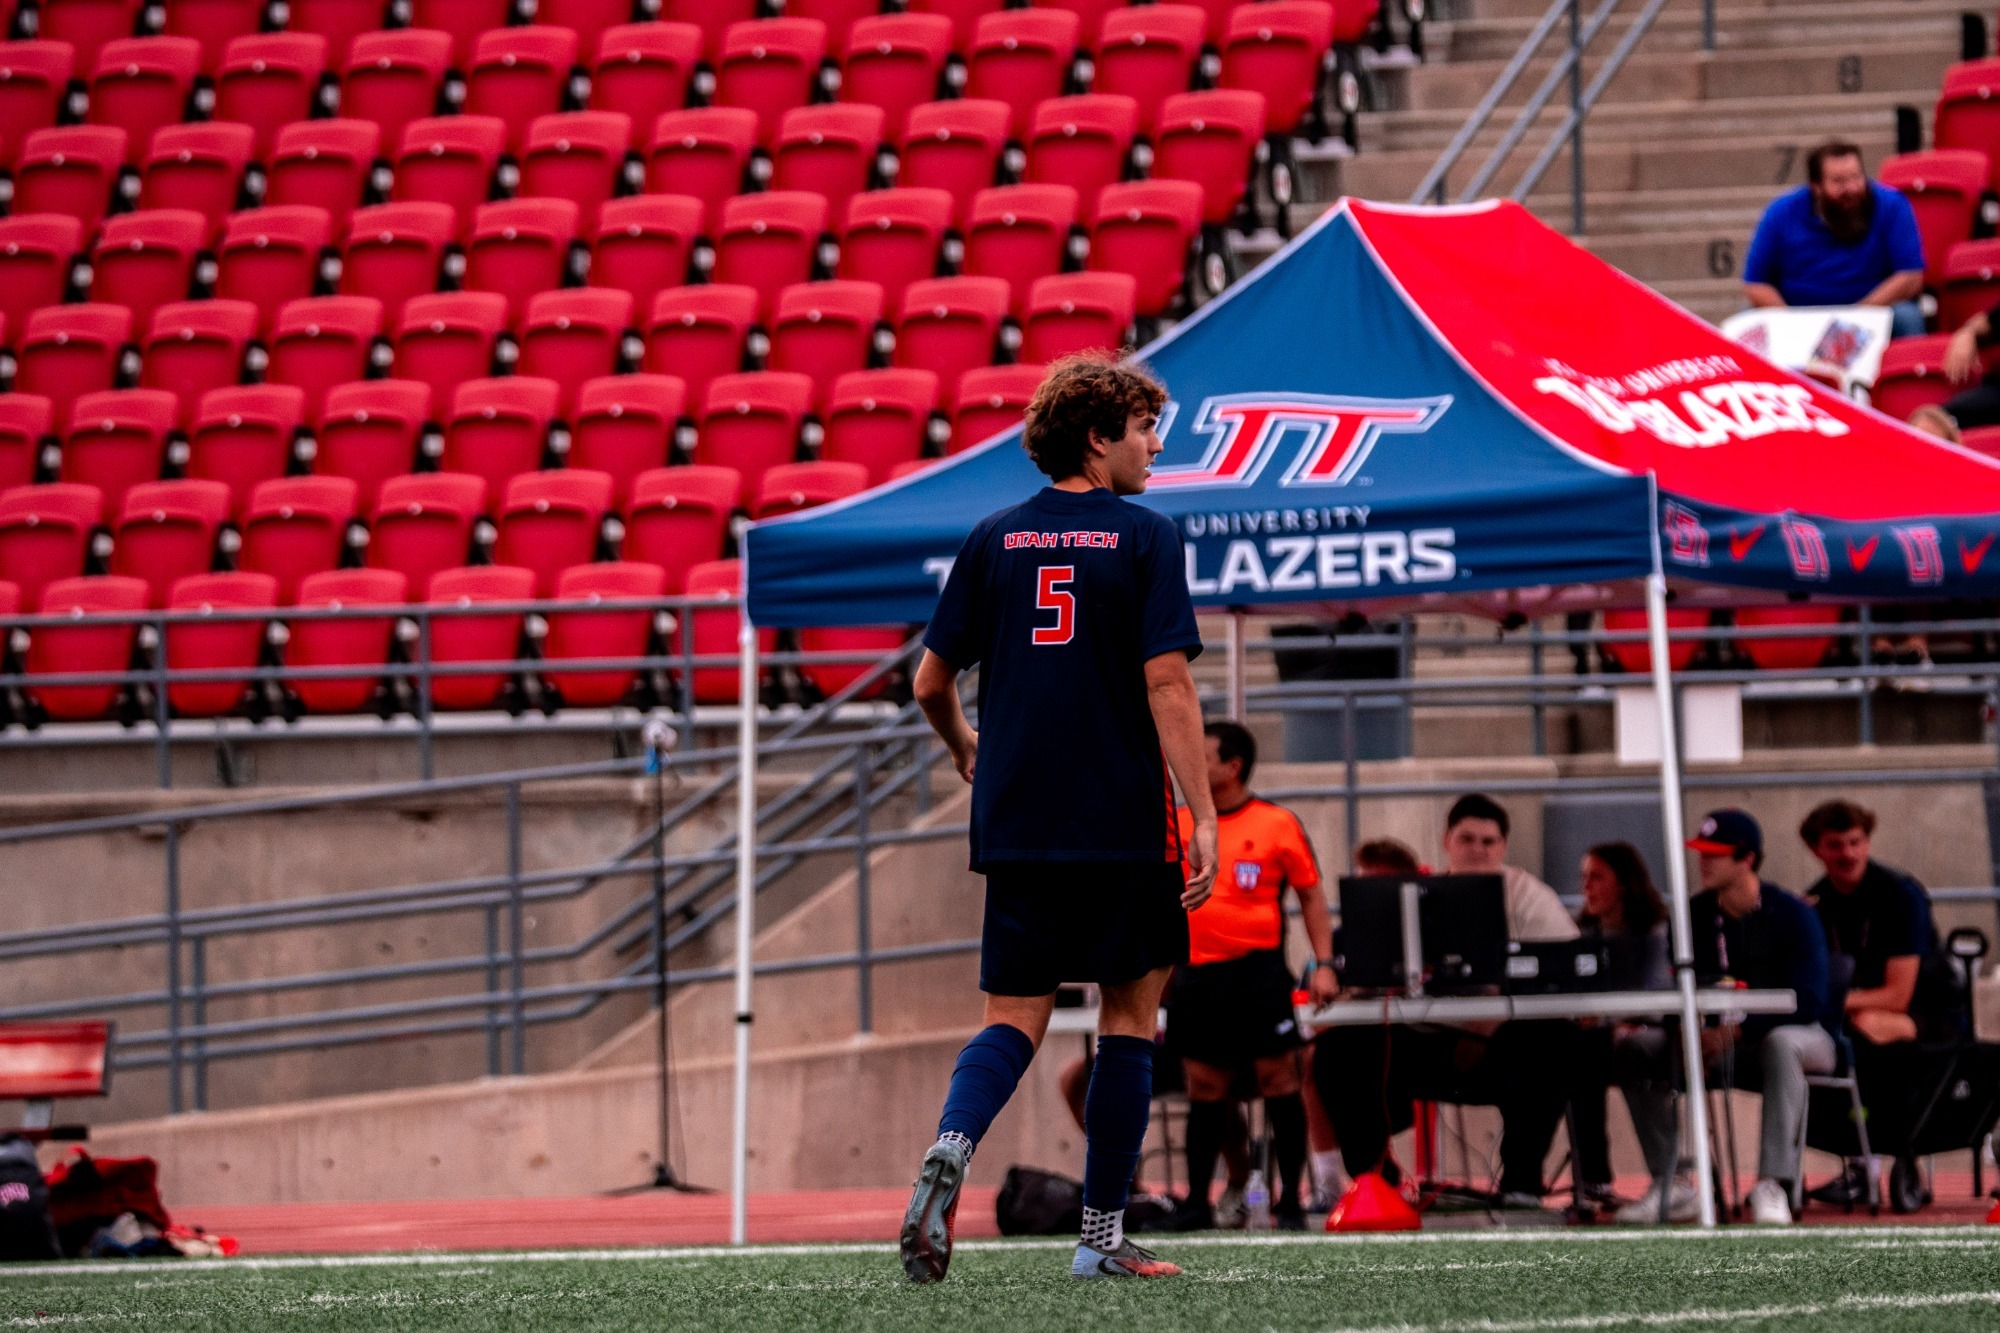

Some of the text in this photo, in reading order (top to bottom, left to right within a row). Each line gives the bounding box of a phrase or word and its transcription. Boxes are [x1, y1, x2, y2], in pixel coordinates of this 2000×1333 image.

[1773, 146, 1798, 184] 7
[1707, 239, 1735, 278] 6
[1621, 355, 1743, 396] UNIVERSITY
[1005, 531, 1119, 550] UTAH TECH
[1185, 505, 1371, 537] UNIVERSITY
[1184, 527, 1457, 596] LAZERS
[1032, 564, 1076, 646] 5
